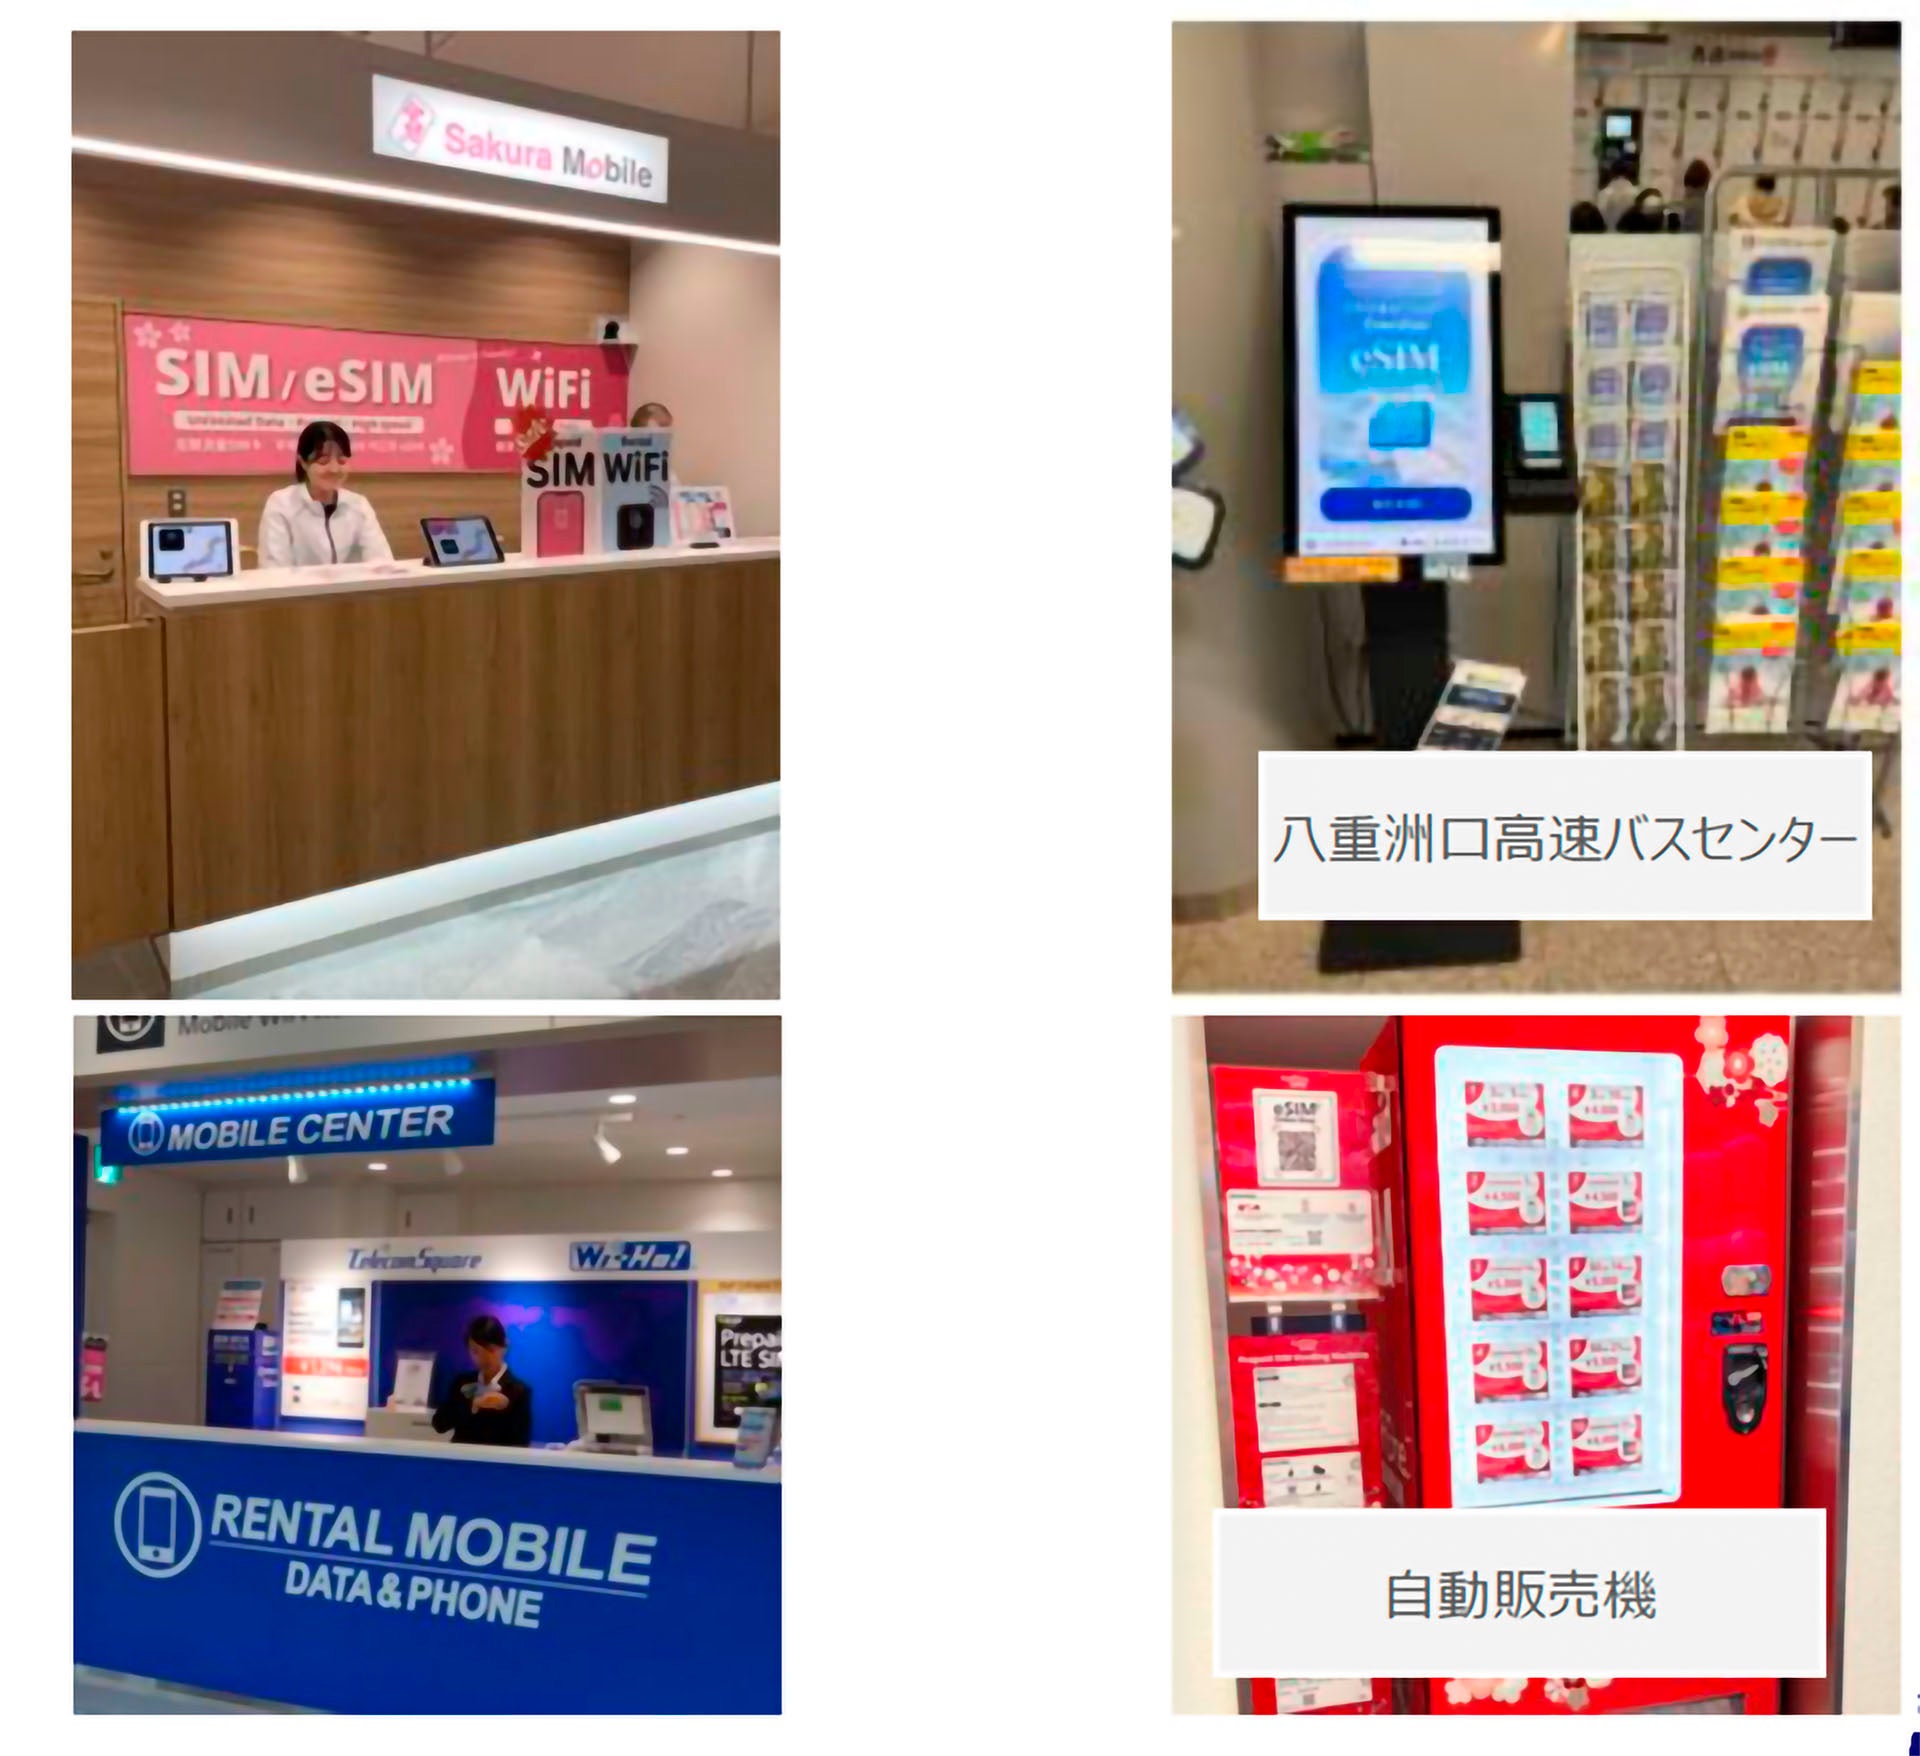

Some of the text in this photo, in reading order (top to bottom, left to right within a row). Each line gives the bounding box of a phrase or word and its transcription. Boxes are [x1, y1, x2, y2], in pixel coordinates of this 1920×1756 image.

[444, 122, 653, 188] Sakura Mobile
[155, 348, 271, 399] SIM
[305, 358, 433, 404] eSIM
[496, 367, 592, 409] WiFi
[526, 451, 596, 489] SIM
[603, 450, 669, 484] WiFi
[167, 1104, 455, 1152] MOBILE CENTER
[720, 1349, 753, 1368] LTE
[210, 1493, 658, 1586] RENTAL MOBILE
[284, 1560, 544, 1629] DATA&PHONE
